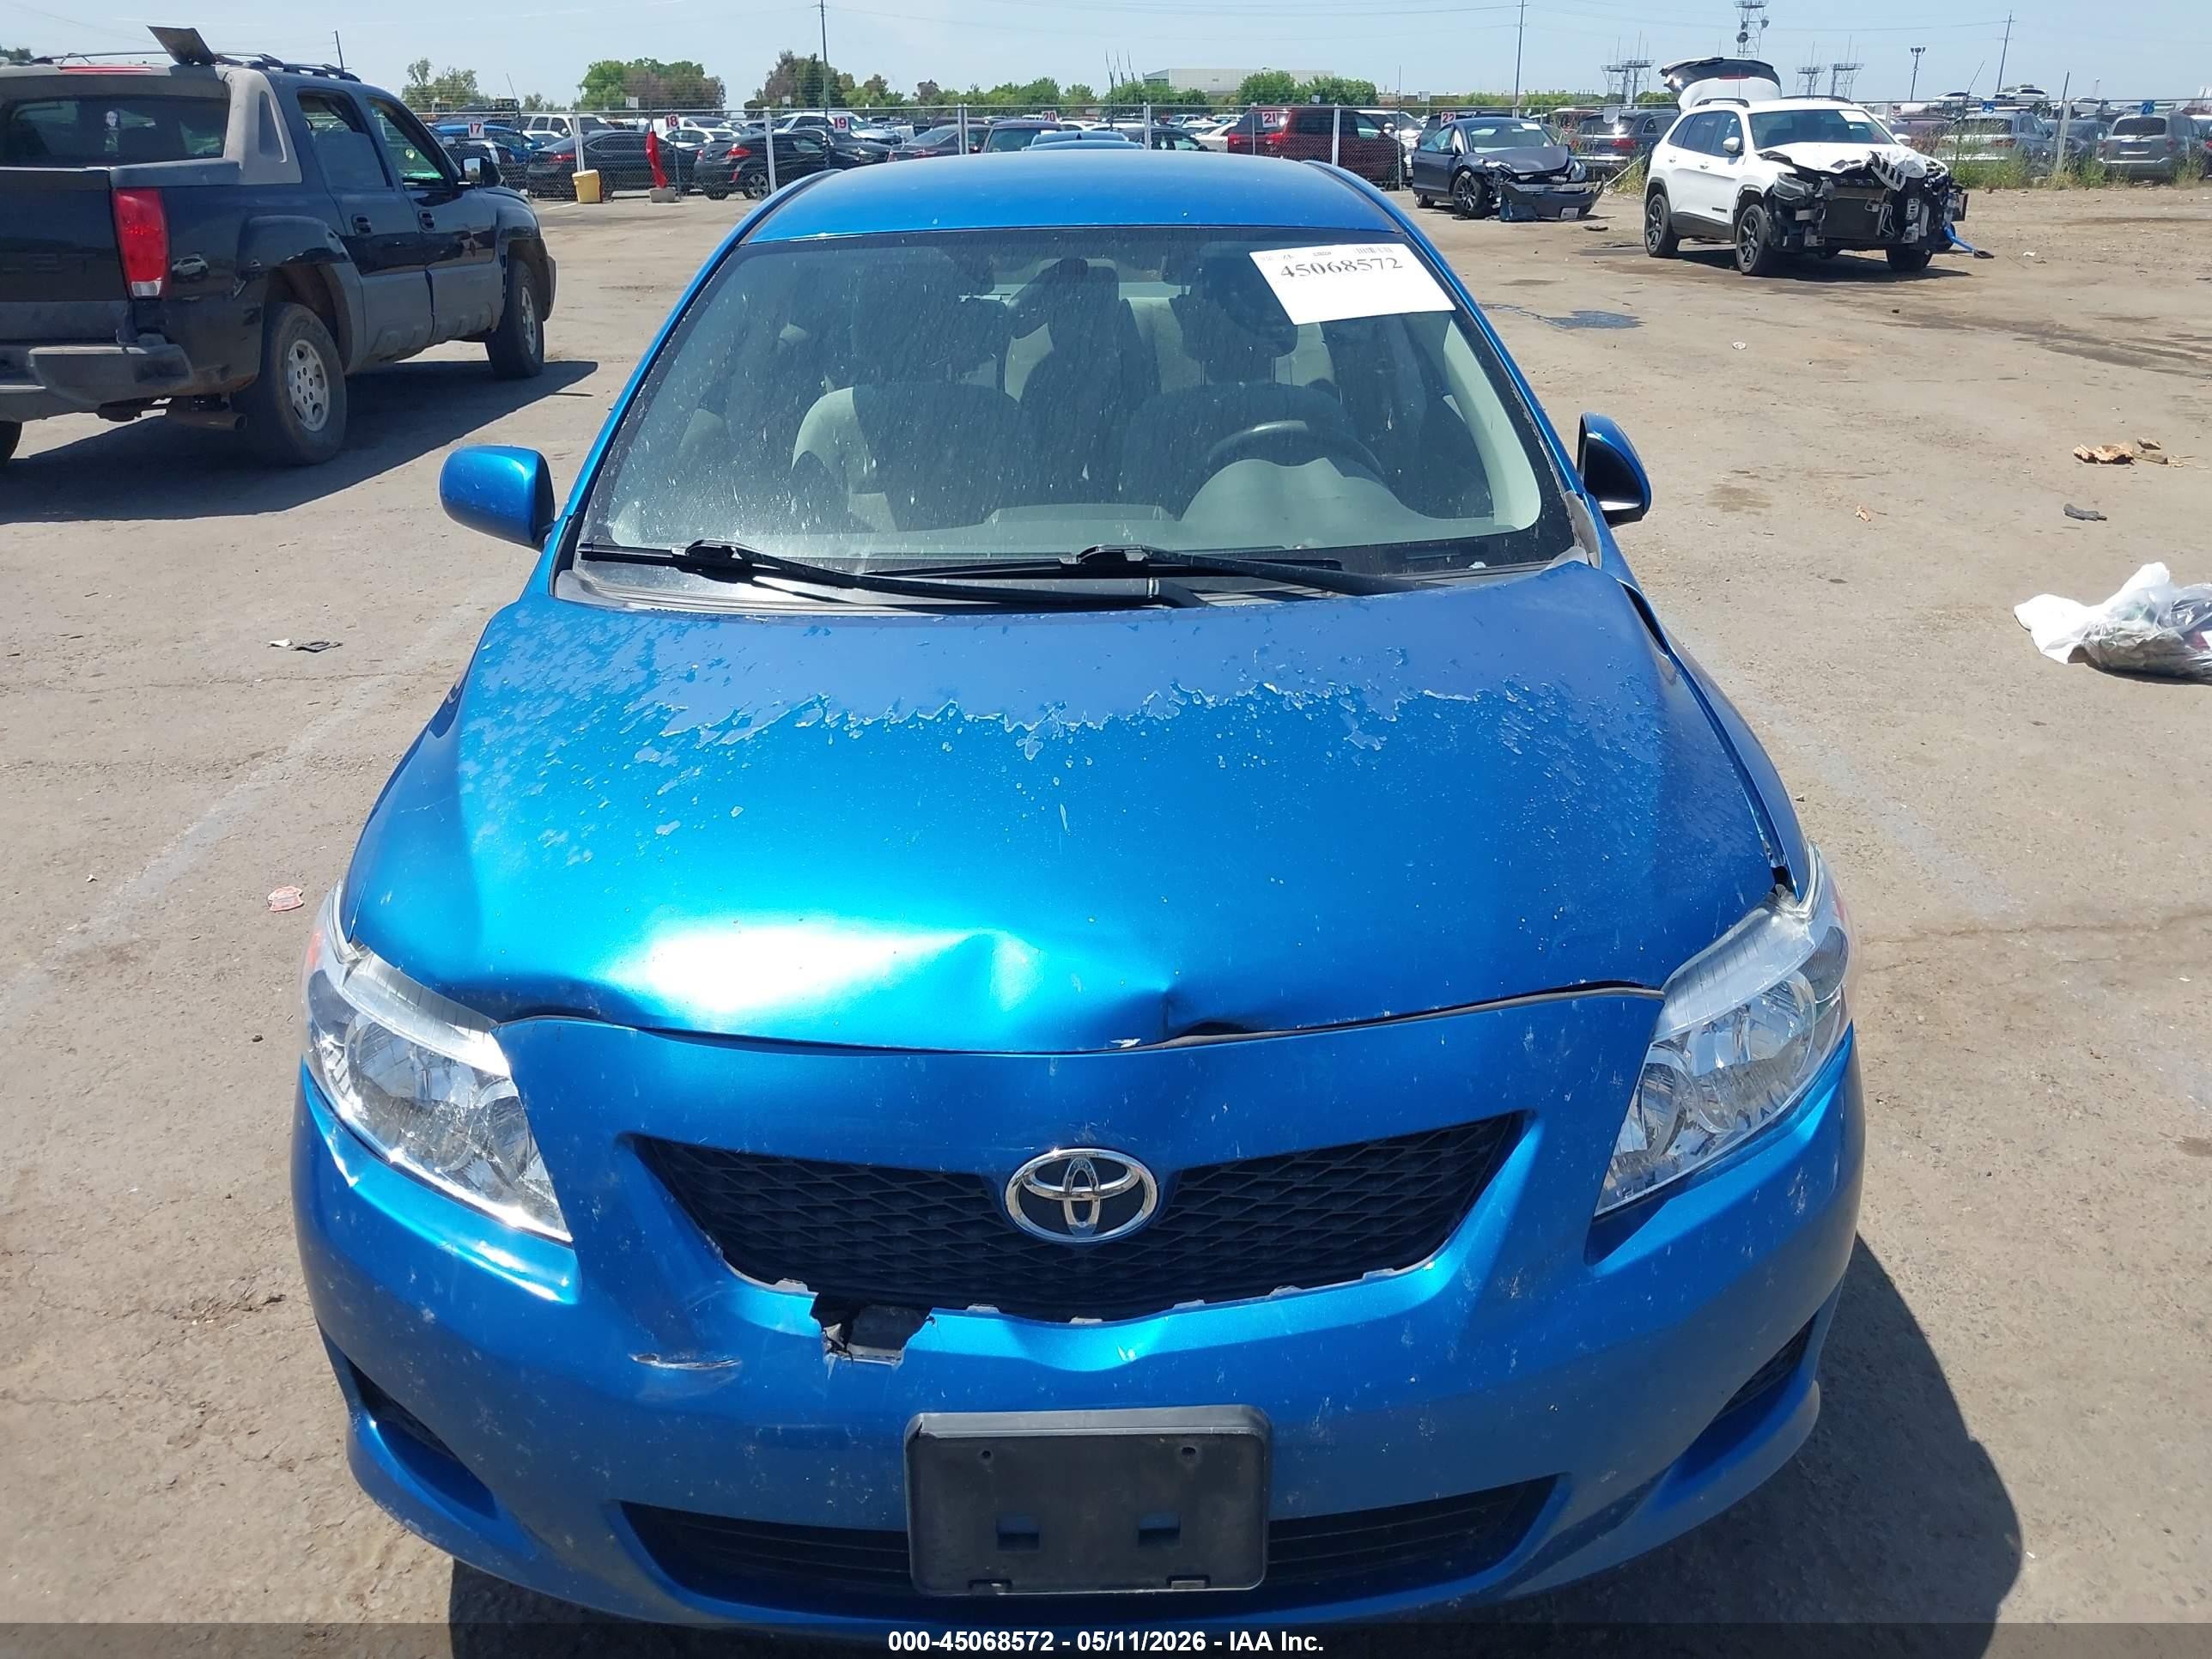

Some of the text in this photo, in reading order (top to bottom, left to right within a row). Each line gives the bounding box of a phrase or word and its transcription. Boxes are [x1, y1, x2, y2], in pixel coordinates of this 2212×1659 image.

[1982, 101, 1996, 113] 25
[2142, 101, 2155, 114] 26
[665, 115, 678, 127] 18
[833, 117, 848, 128] 19
[1044, 112, 1056, 122] 20
[1263, 112, 1276, 124] 21
[1442, 112, 1455, 124] 22
[469, 123, 483, 133] 17
[1280, 257, 1404, 278] 45068572
